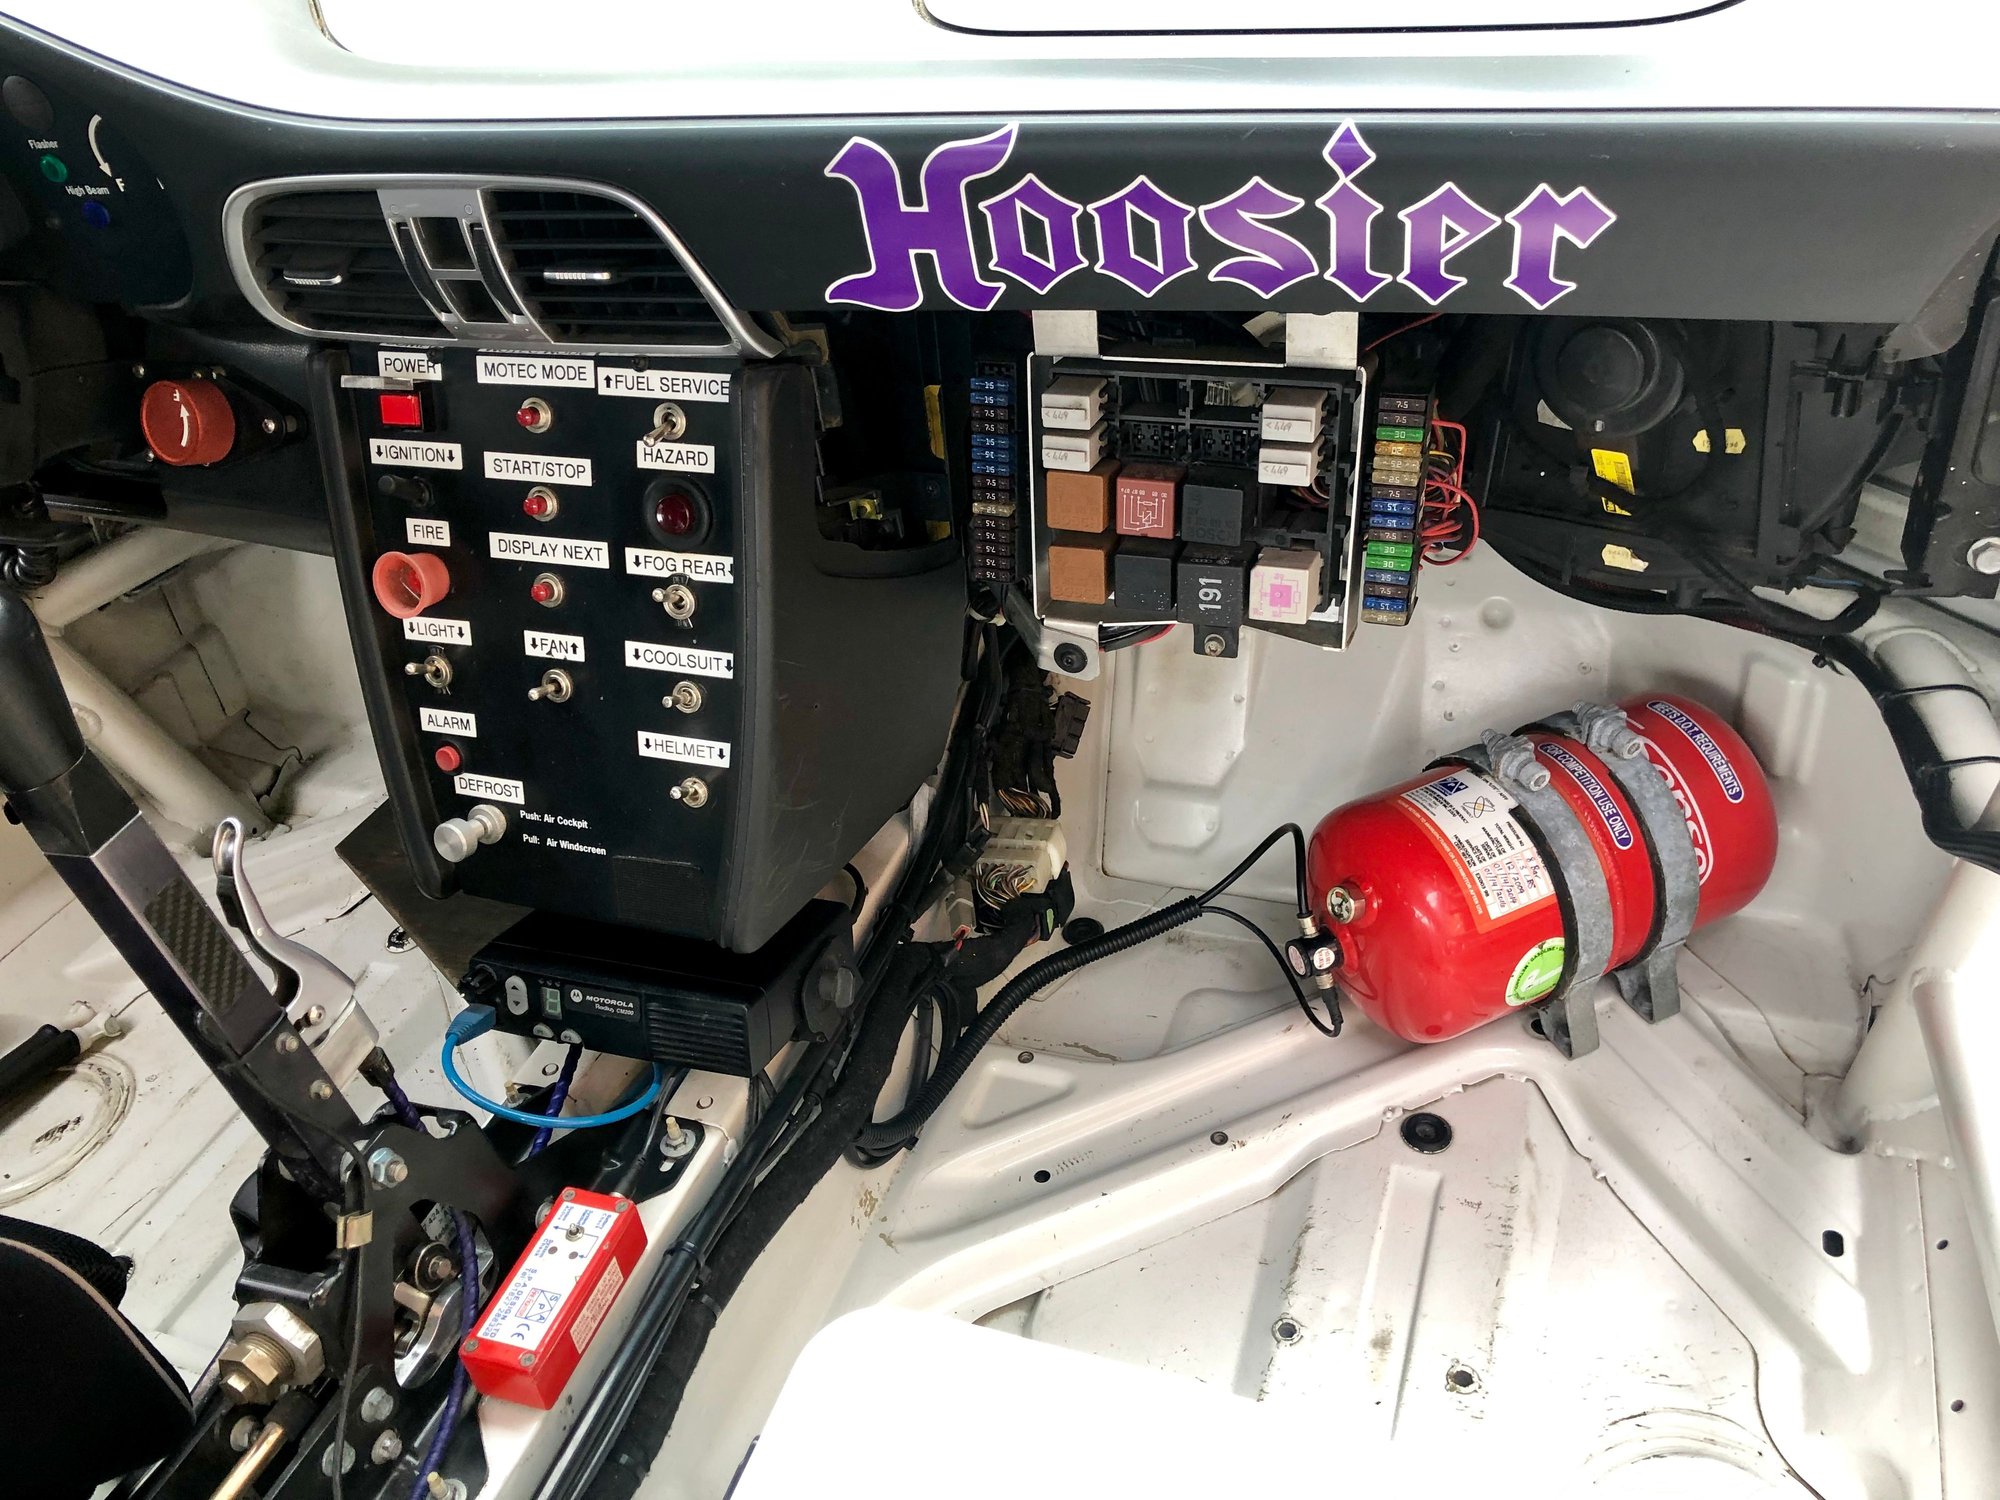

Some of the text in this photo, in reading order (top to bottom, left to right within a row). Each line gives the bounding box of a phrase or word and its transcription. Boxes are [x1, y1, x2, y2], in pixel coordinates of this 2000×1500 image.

[28, 138, 59, 150] Flasher
[65, 185, 110, 197] High Beam
[823, 118, 1617, 313] Hoosier
[384, 357, 437, 375] POWER
[484, 361, 588, 381] MOTEC MODE
[615, 375, 730, 396] FUEL SERVICE
[385, 445, 446, 463] IGNITION
[643, 450, 709, 467] HAZARD
[493, 459, 587, 479] START/STOP
[413, 525, 444, 540] FIRE
[499, 539, 603, 562] DISPLAY NEXT
[644, 555, 725, 577] FOG REAR
[1199, 578, 1222, 611] 191
[417, 622, 455, 639] LIGHT
[541, 638, 569, 654] FAN
[643, 648, 723, 672] COOLSUIT
[427, 714, 471, 731] ALARM
[654, 738, 715, 760] HELMET
[1655, 702, 1678, 719] MEETS
[1693, 733, 1740, 796] REQUIREMENTS
[459, 777, 521, 799] DEFROST
[1558, 752, 1601, 801] COMPETITION
[1599, 797, 1617, 816] USE
[1609, 815, 1631, 842] ONLY
[519, 810, 588, 830] Push: Air Cockpit
[522, 834, 606, 856] Pull: Air Windscreen
[1423, 821, 1450, 852] MANUFACTURER
[1452, 857, 1472, 889] DISTRIBUTOR
[1468, 888, 1479, 905] AFTER
[586, 995, 634, 1008] MOTOROLA
[500, 1289, 523, 1321] DESIGN
[488, 1322, 502, 1338] LTD
